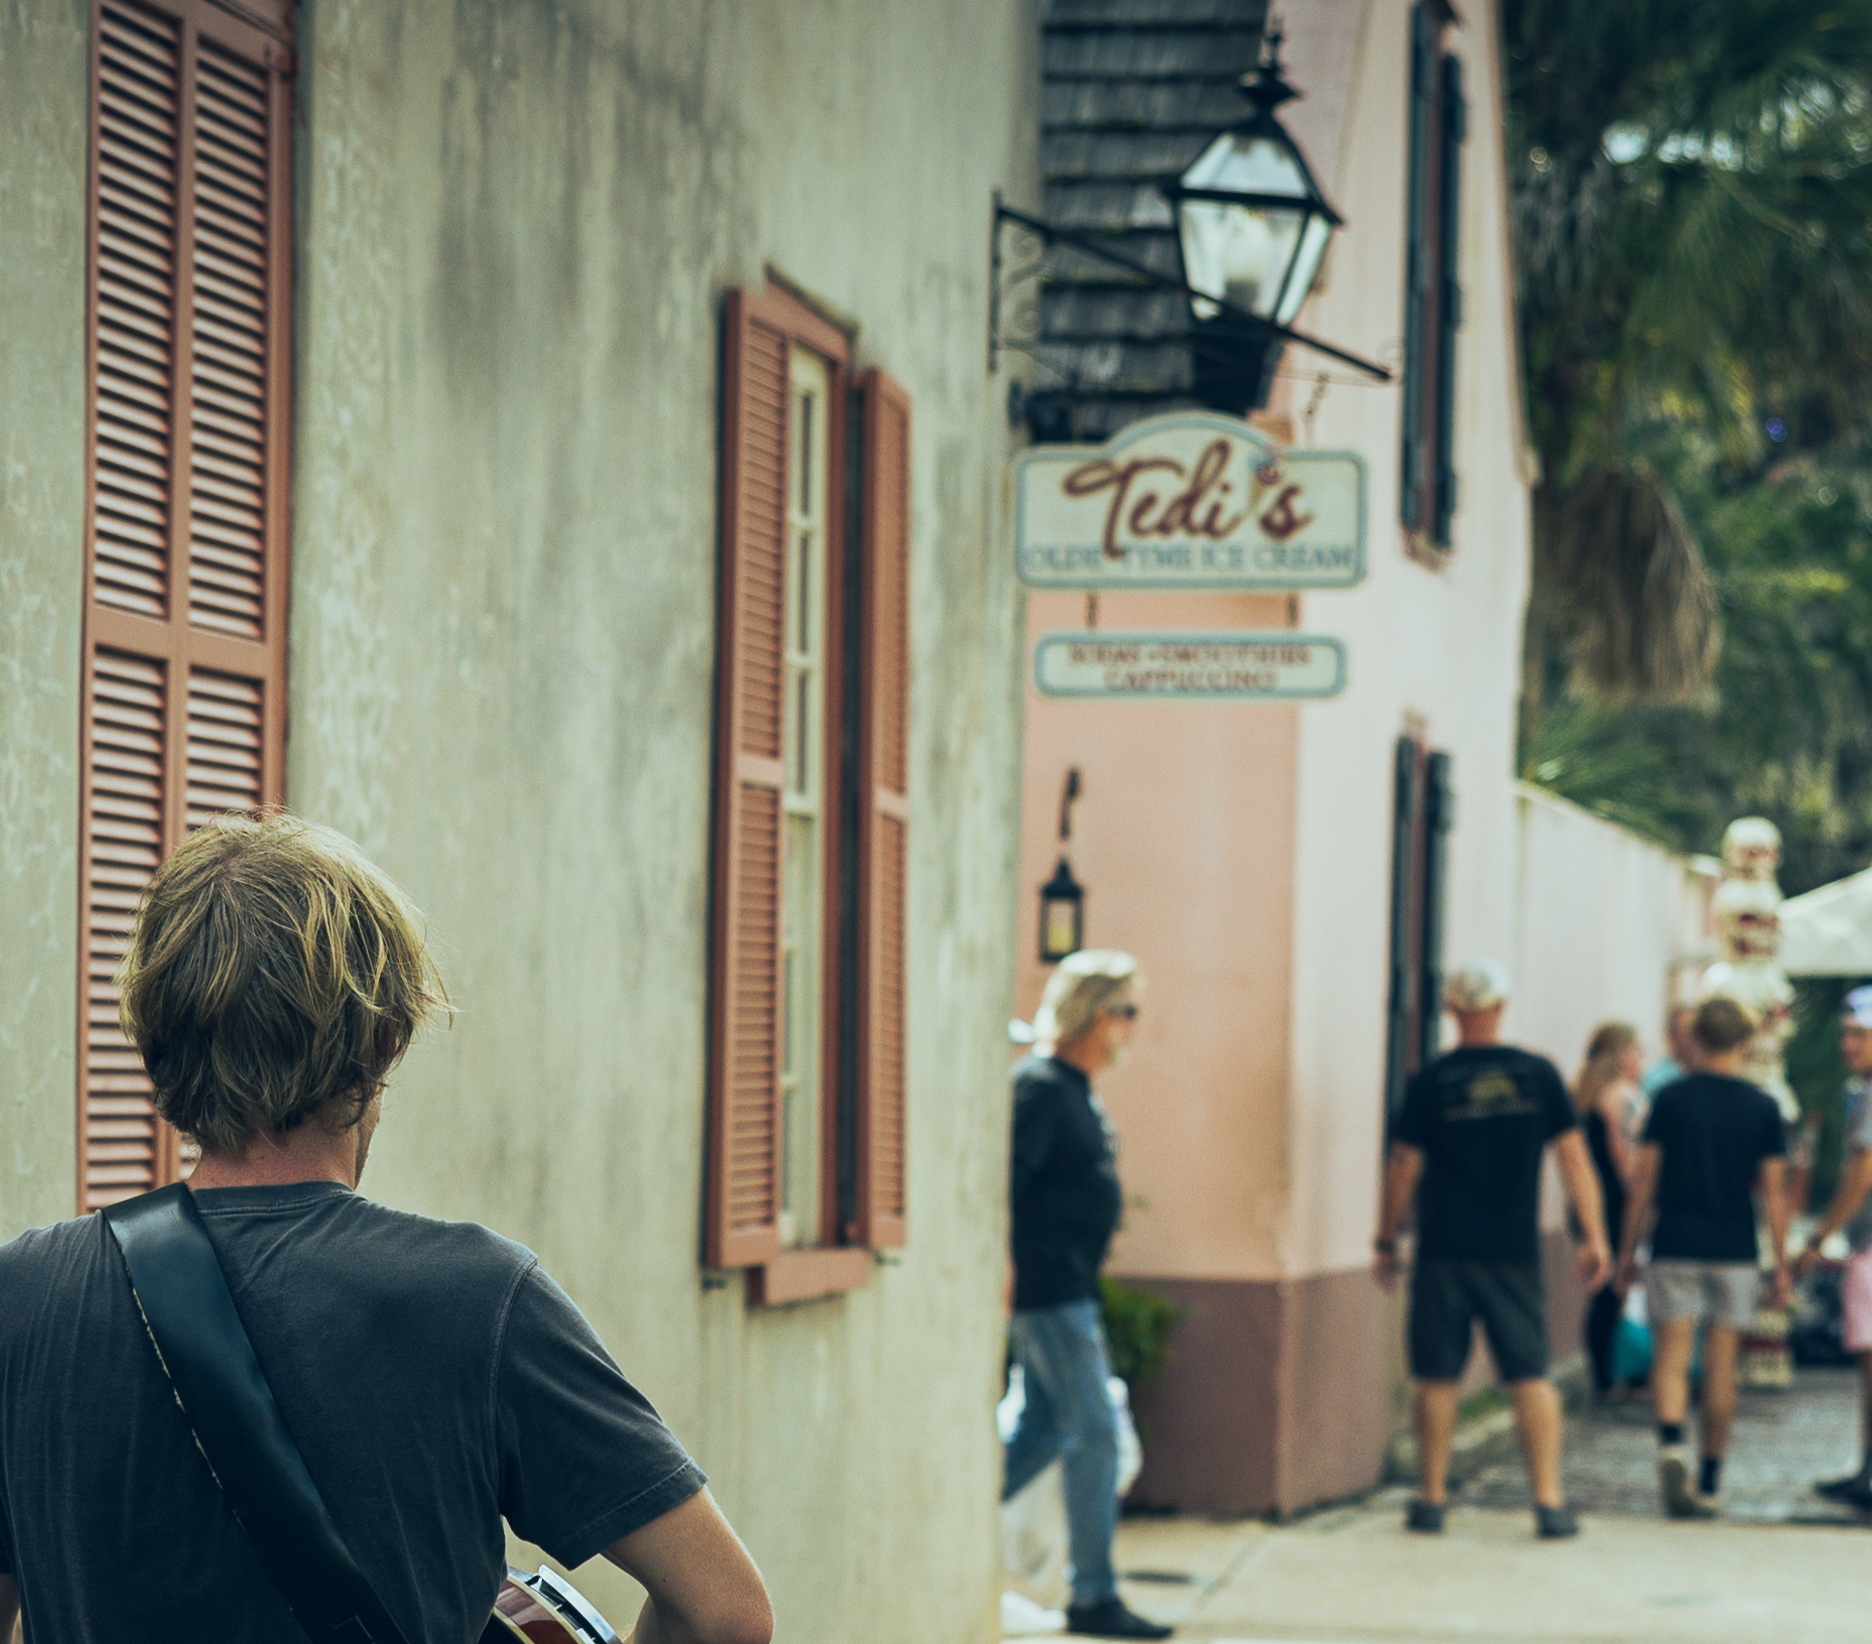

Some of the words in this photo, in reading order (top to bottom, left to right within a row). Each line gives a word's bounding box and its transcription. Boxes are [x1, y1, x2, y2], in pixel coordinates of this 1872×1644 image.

[1027, 544, 1105, 570] OLDE
[1202, 544, 1245, 570] ICE
[1254, 544, 1355, 570] CREAM
